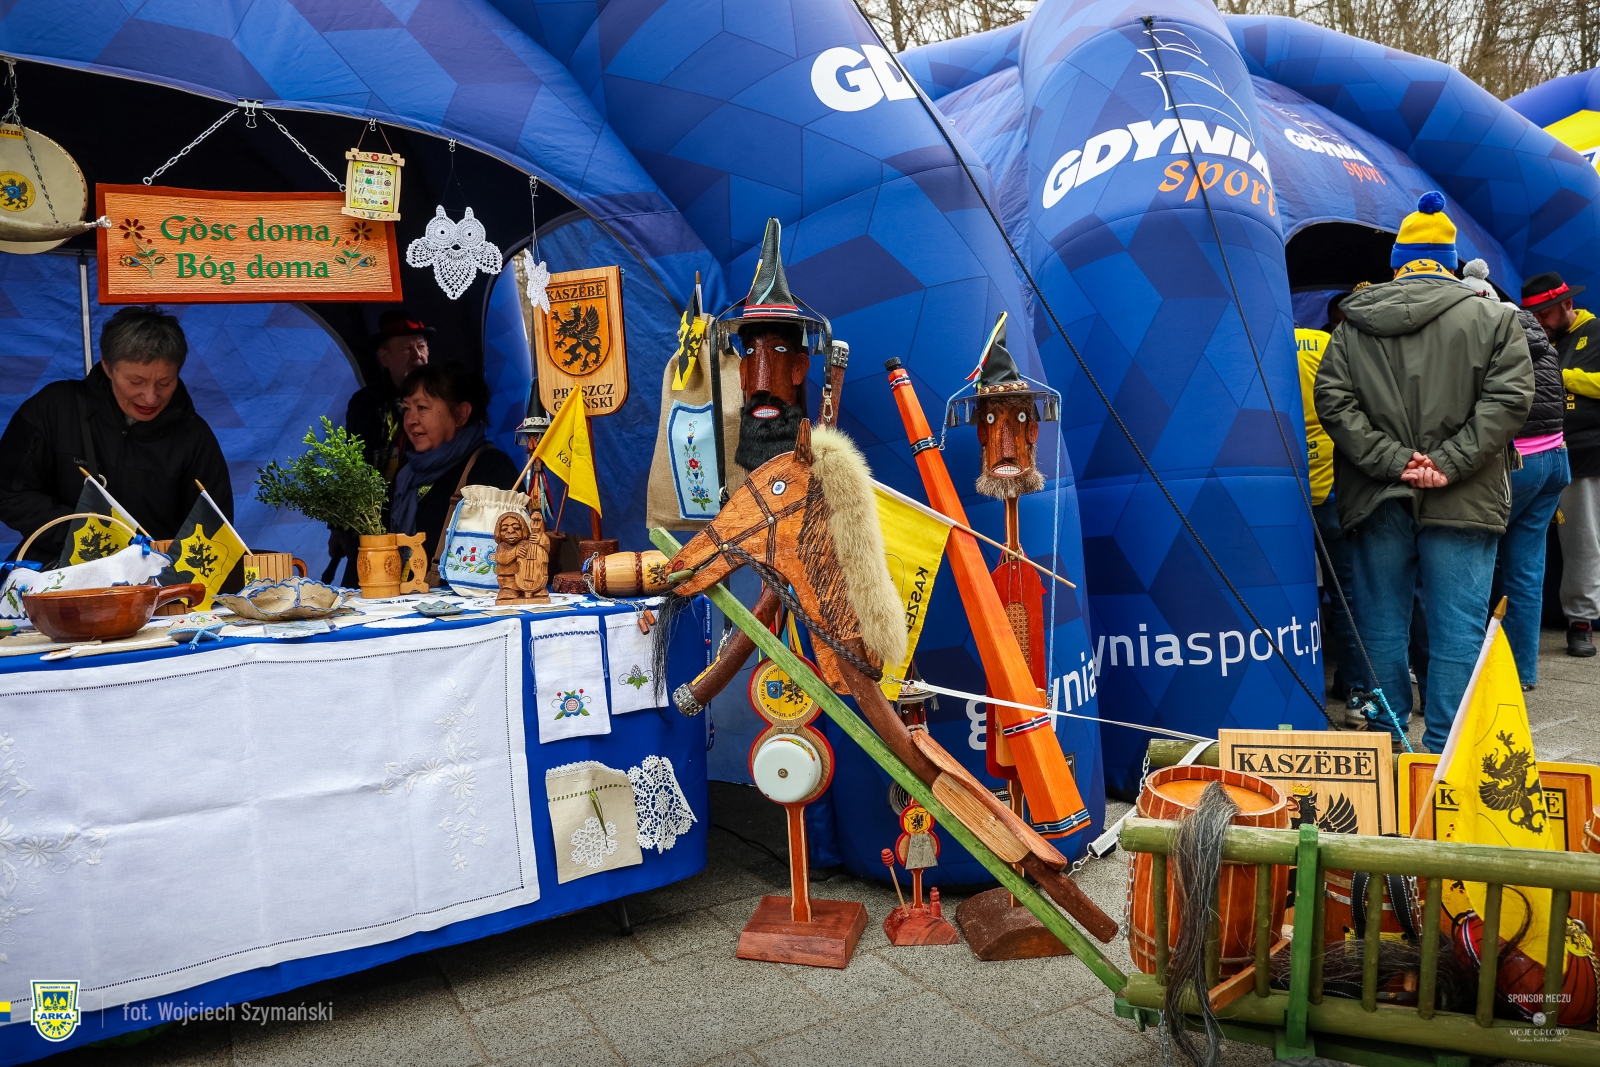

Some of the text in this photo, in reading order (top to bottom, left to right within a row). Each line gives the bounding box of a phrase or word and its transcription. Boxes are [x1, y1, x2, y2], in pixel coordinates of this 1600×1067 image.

[1042, 118, 1272, 209] GDYNIA
[1342, 160, 1387, 186] sport
[1158, 160, 1276, 217] sport
[160, 215, 340, 247] Gòsc doma,
[175, 252, 330, 285] Bóg doma
[553, 384, 614, 399] PRSZCZ
[553, 397, 614, 412] GŃSKI
[1238, 751, 1372, 776] KASZËBË
